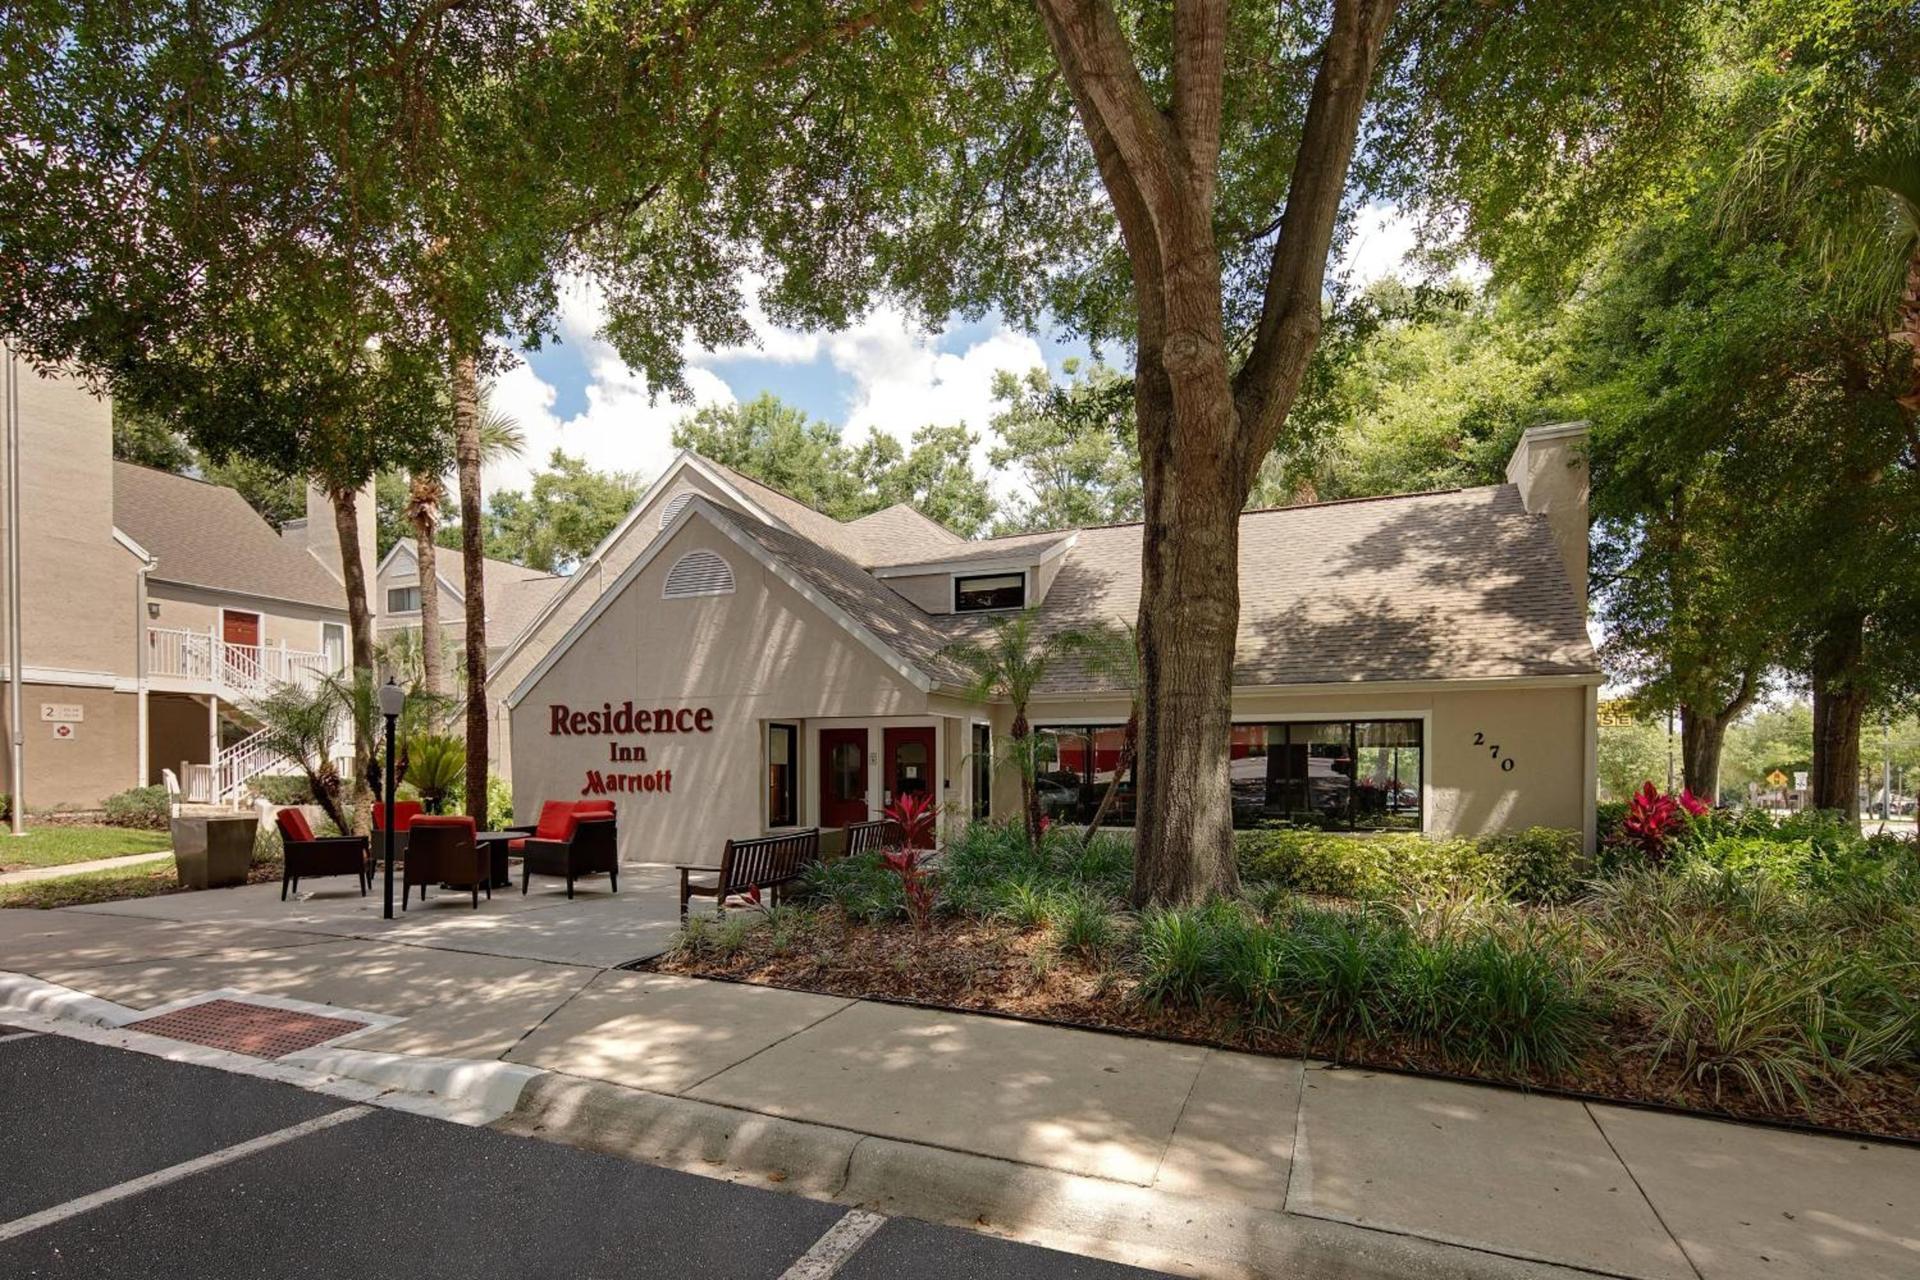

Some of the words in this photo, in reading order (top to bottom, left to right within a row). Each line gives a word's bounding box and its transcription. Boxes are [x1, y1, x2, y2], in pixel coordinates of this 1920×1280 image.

[46, 706, 54, 717] 2
[549, 701, 714, 735] Residence
[609, 742, 647, 762] Inn
[1473, 732, 1515, 772] 270
[581, 769, 672, 796] Marriott
